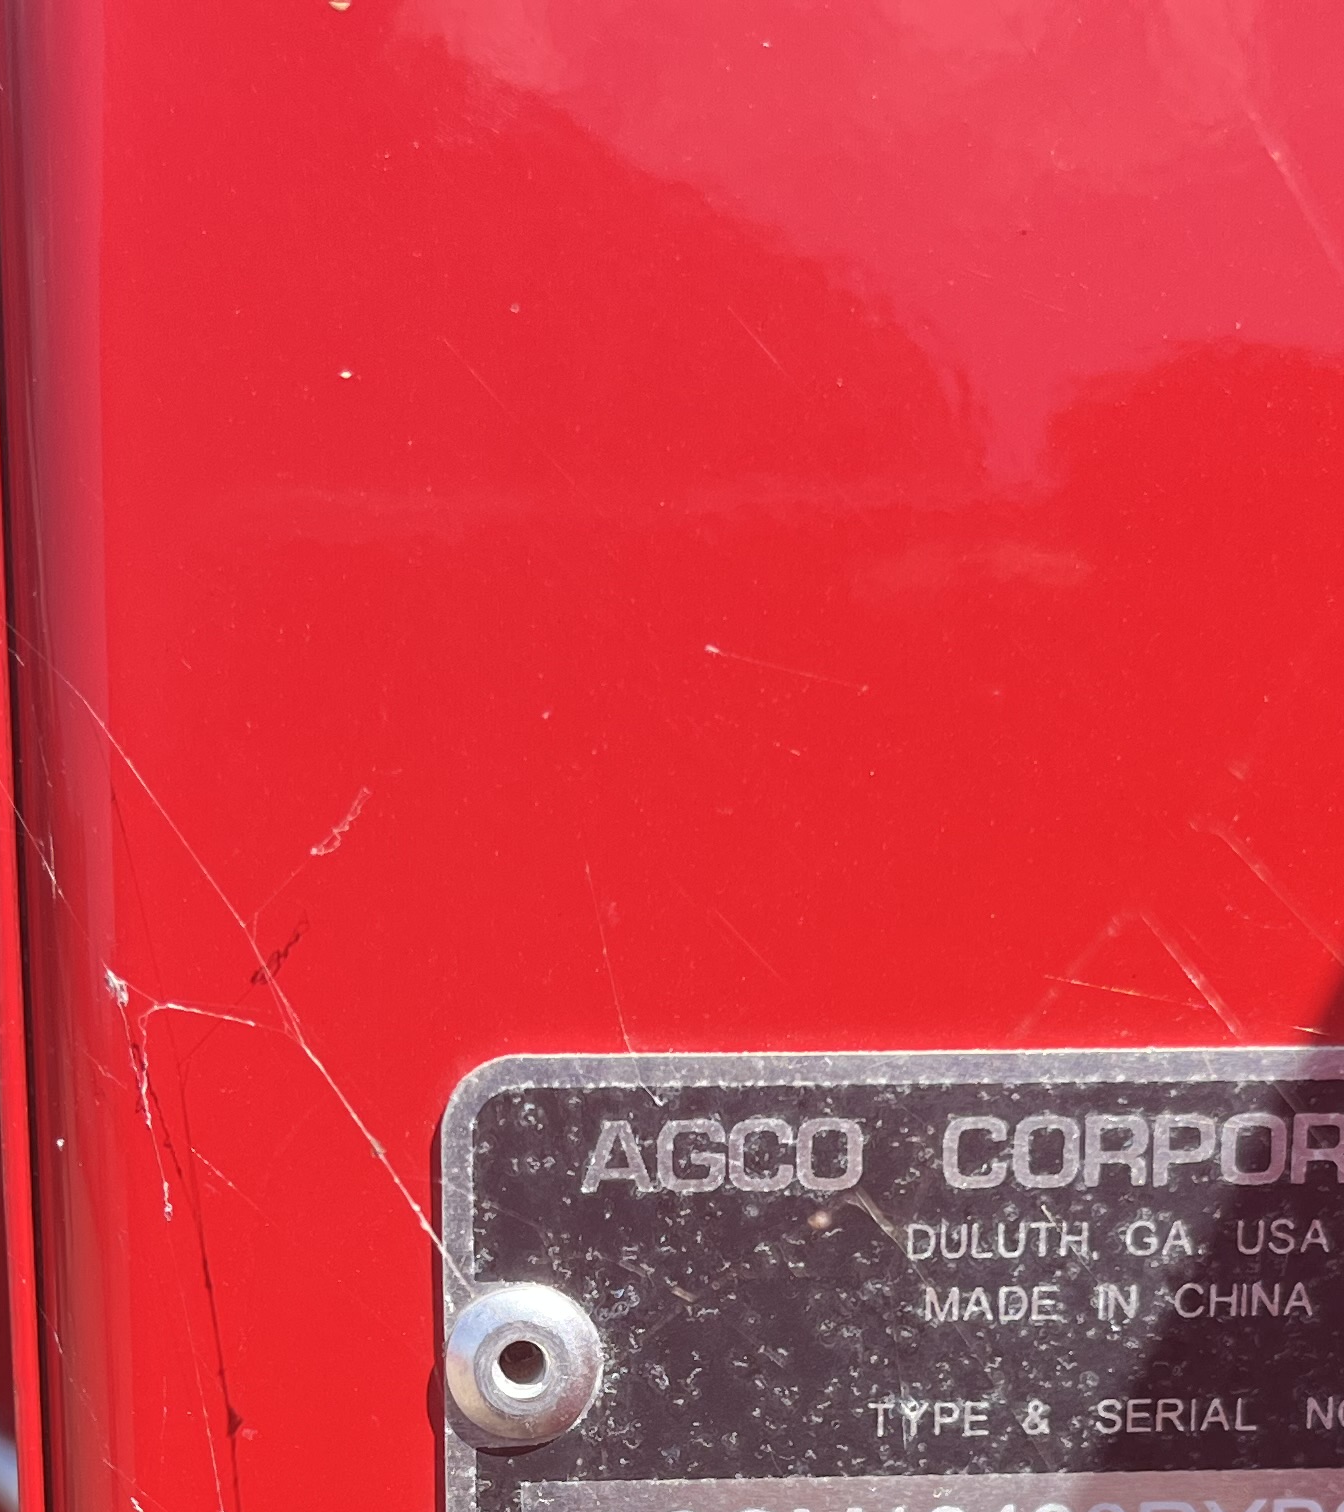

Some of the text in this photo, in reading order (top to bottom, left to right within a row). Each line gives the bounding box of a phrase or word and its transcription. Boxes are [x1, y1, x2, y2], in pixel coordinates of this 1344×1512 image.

[580, 1117, 864, 1194] AGCO
[1236, 1219, 1330, 1255] USA
[924, 1281, 1314, 1323] MADE IN CHINA
[868, 1401, 990, 1438] TYPE
[1023, 1400, 1051, 1435] &
[1096, 1398, 1258, 1434] SERIAL
